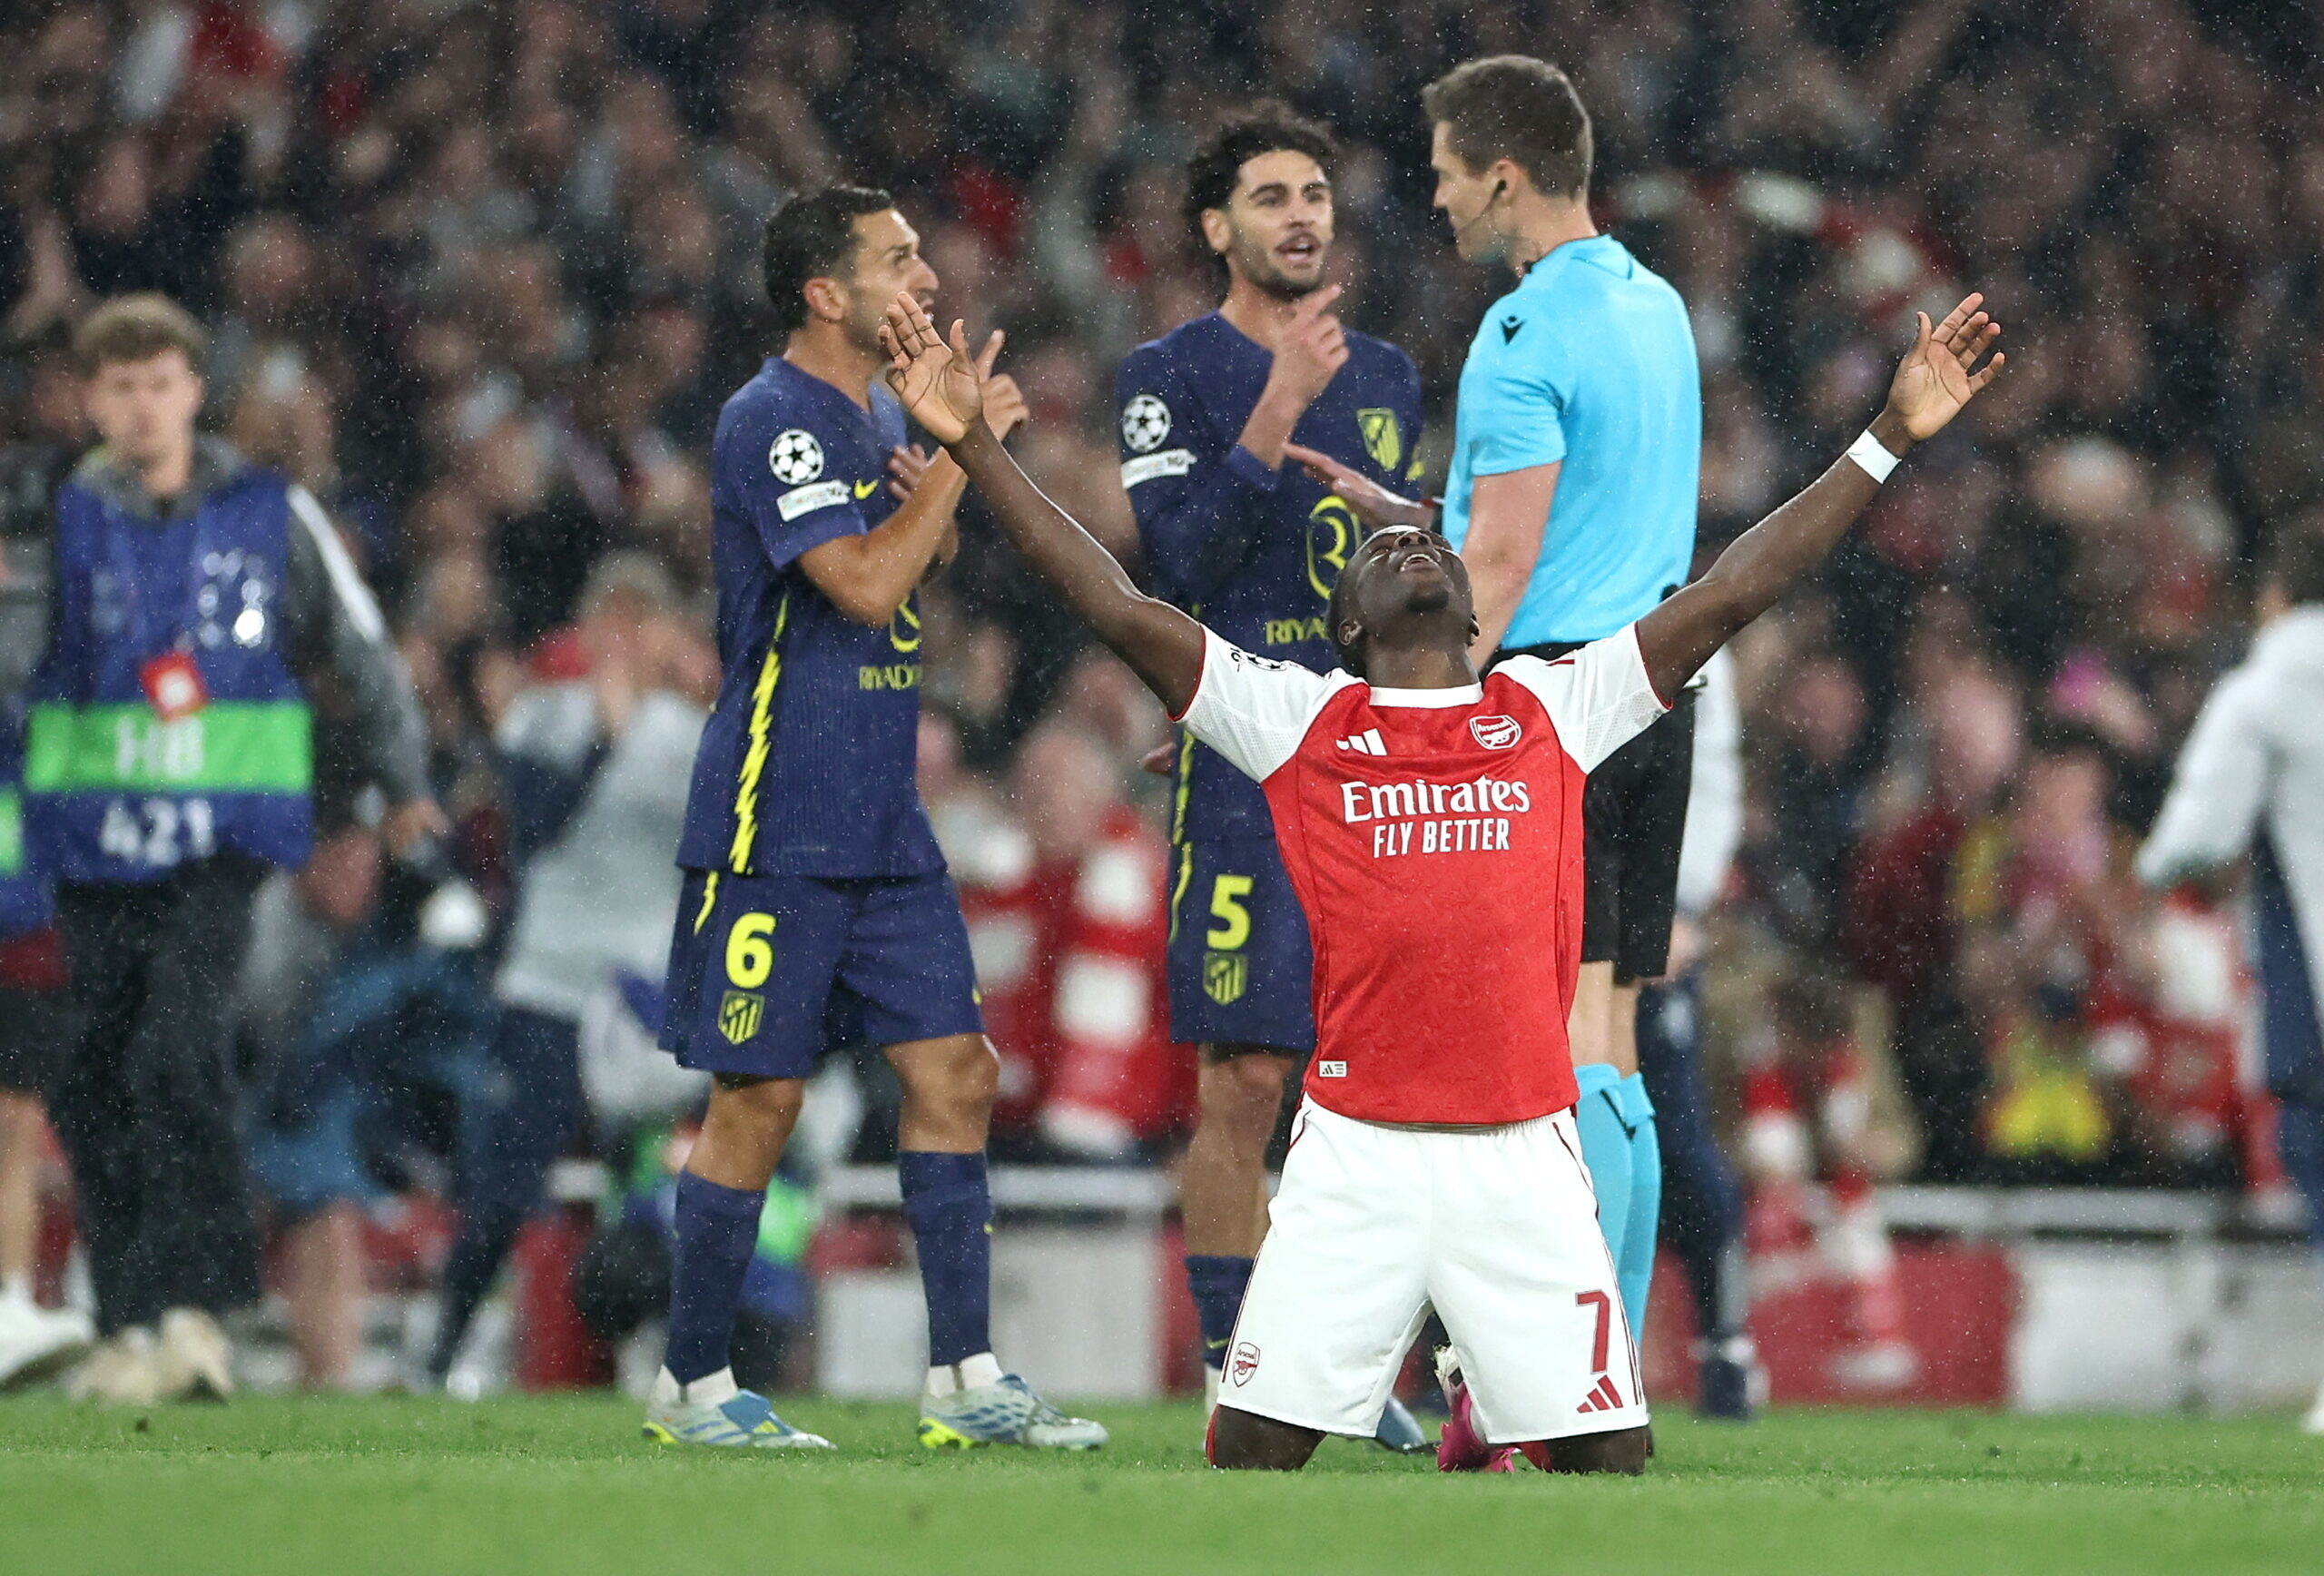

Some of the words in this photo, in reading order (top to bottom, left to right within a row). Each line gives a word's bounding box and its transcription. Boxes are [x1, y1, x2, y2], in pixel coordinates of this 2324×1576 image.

[1266, 617, 1329, 645] RIYA
[102, 796, 214, 867] 421
[1339, 774, 1531, 823] Emirates
[1373, 821, 1413, 858] FLY
[1422, 817, 1510, 853] BETTER
[1206, 874, 1254, 951] 5
[725, 911, 777, 989] 6
[1576, 1289, 1610, 1374] 7
